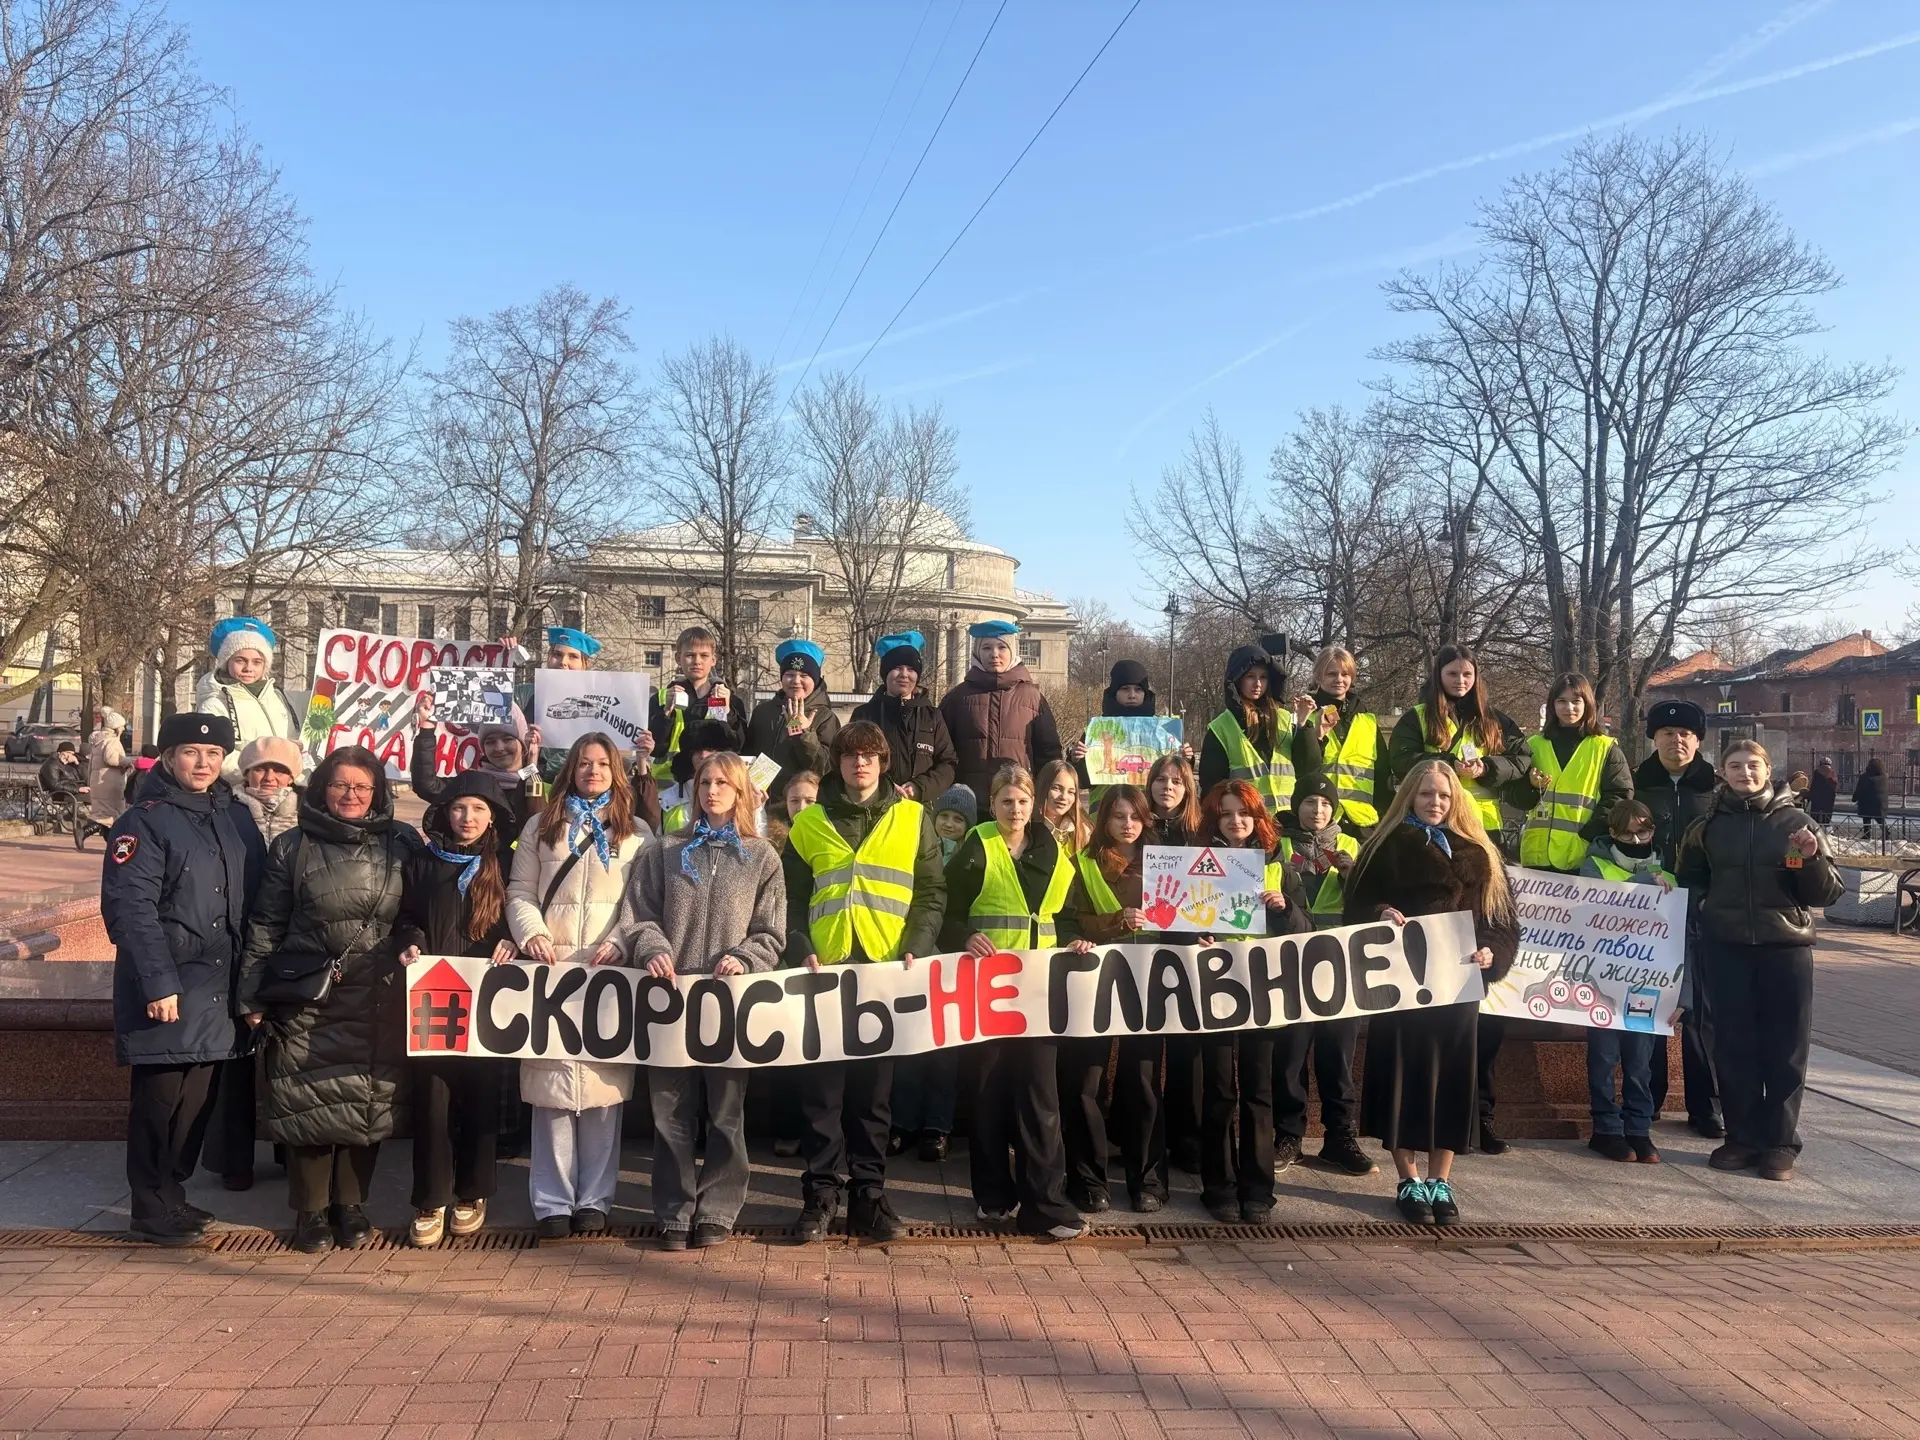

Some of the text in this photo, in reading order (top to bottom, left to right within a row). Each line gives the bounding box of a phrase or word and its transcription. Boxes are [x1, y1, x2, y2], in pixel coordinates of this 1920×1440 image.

[583, 694, 612, 705] СКОРОСТЬ
[600, 709, 644, 745] ГЛАВНОЕ
[1149, 861, 1178, 870] ДЕТИ!
[1508, 877, 1662, 911] одитель, помни!
[1586, 913, 1669, 939] может
[1592, 934, 1654, 962] твои
[1048, 919, 1433, 1034] ГЛАВНОЕ!
[1600, 963, 1684, 994] жизнь!
[1554, 987, 1565, 997] 60
[1580, 990, 1591, 1000] 90
[1533, 1002, 1544, 1012] 40
[1595, 1011, 1607, 1021] 110
